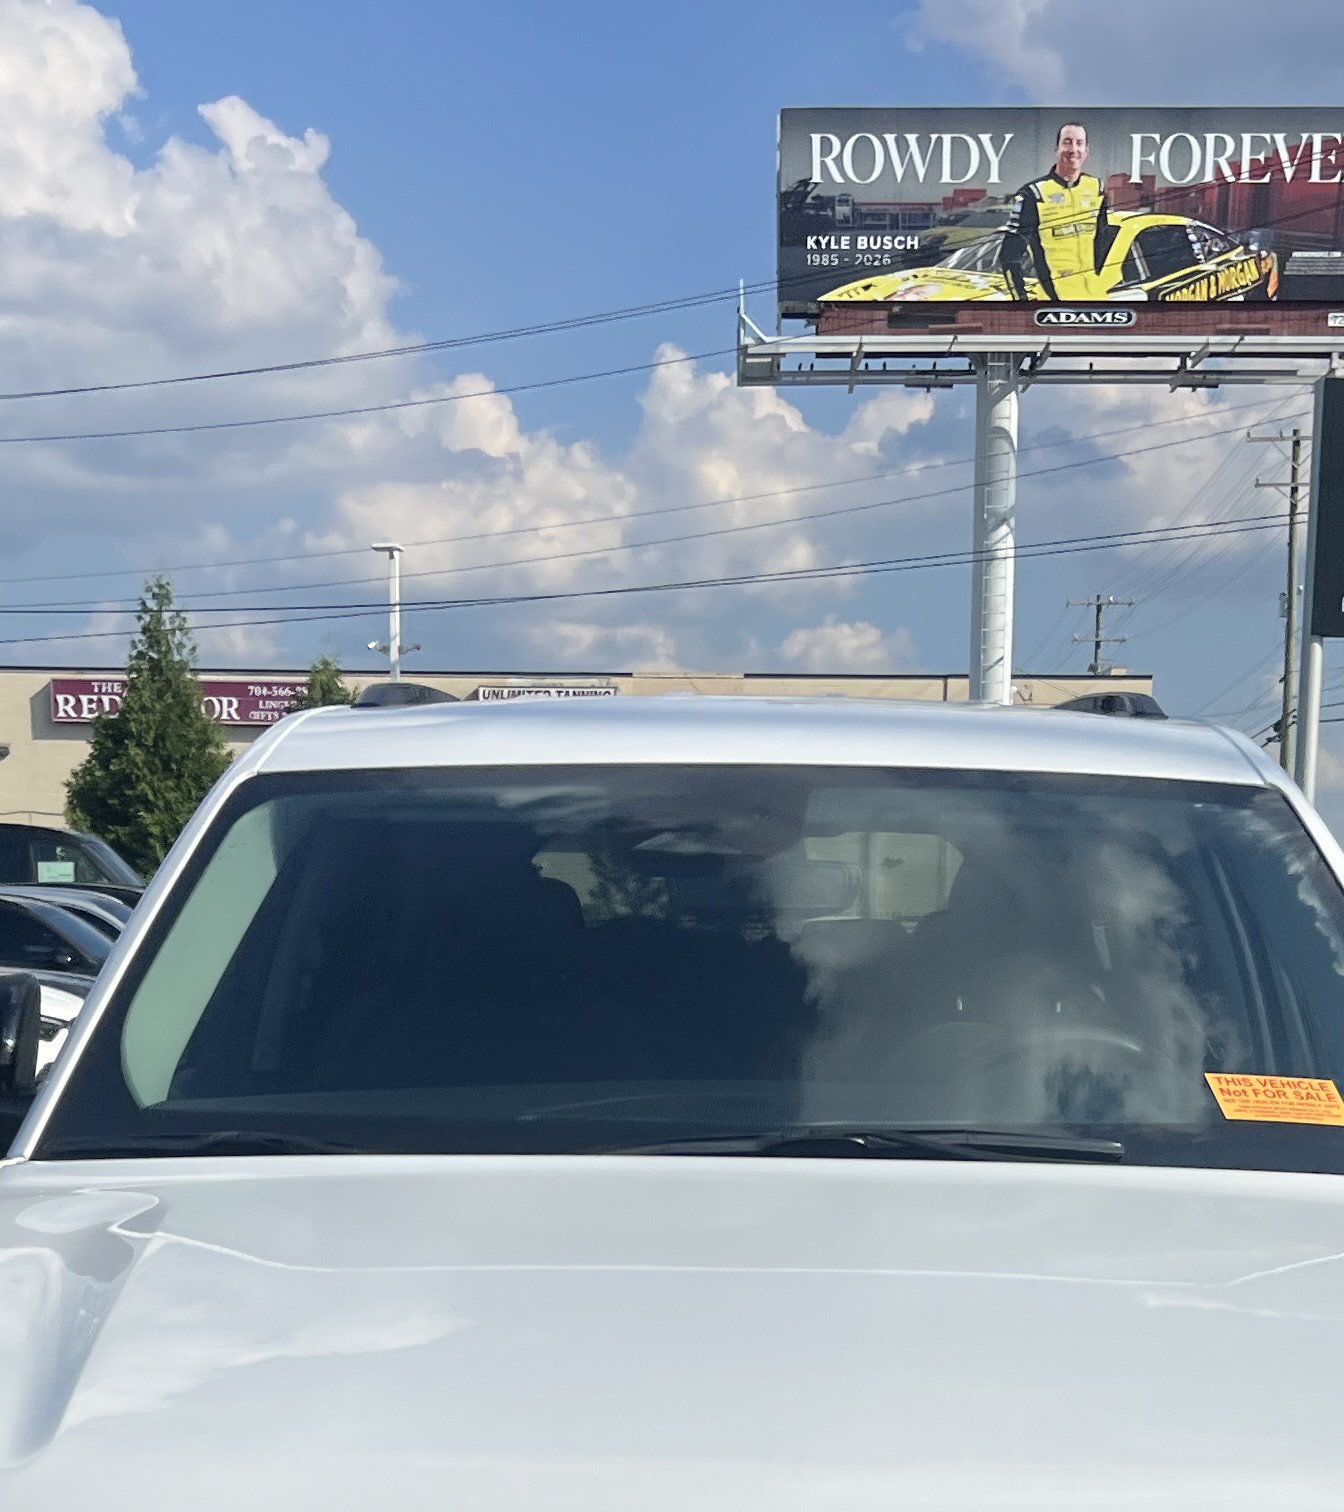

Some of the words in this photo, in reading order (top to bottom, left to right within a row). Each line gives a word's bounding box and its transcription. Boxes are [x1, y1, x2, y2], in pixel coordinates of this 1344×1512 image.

[809, 132, 1014, 184] ROWDY
[806, 235, 851, 250] KYLE
[857, 235, 920, 250] BUSCH
[806, 253, 839, 266] 1985
[854, 253, 892, 266] 2026
[1165, 278, 1208, 301] ORGAN
[1217, 257, 1260, 295] MORGAN
[1042, 312, 1128, 323] ADAMS
[91, 682, 123, 693] THE
[56, 694, 124, 719] RED
[200, 697, 240, 720] OR
[1214, 1076, 1253, 1087] THIS
[1256, 1078, 1330, 1092] VEHICLE
[1219, 1087, 1251, 1098] Not
[1254, 1088, 1289, 1099] FOR
[1292, 1090, 1338, 1103] SALE
